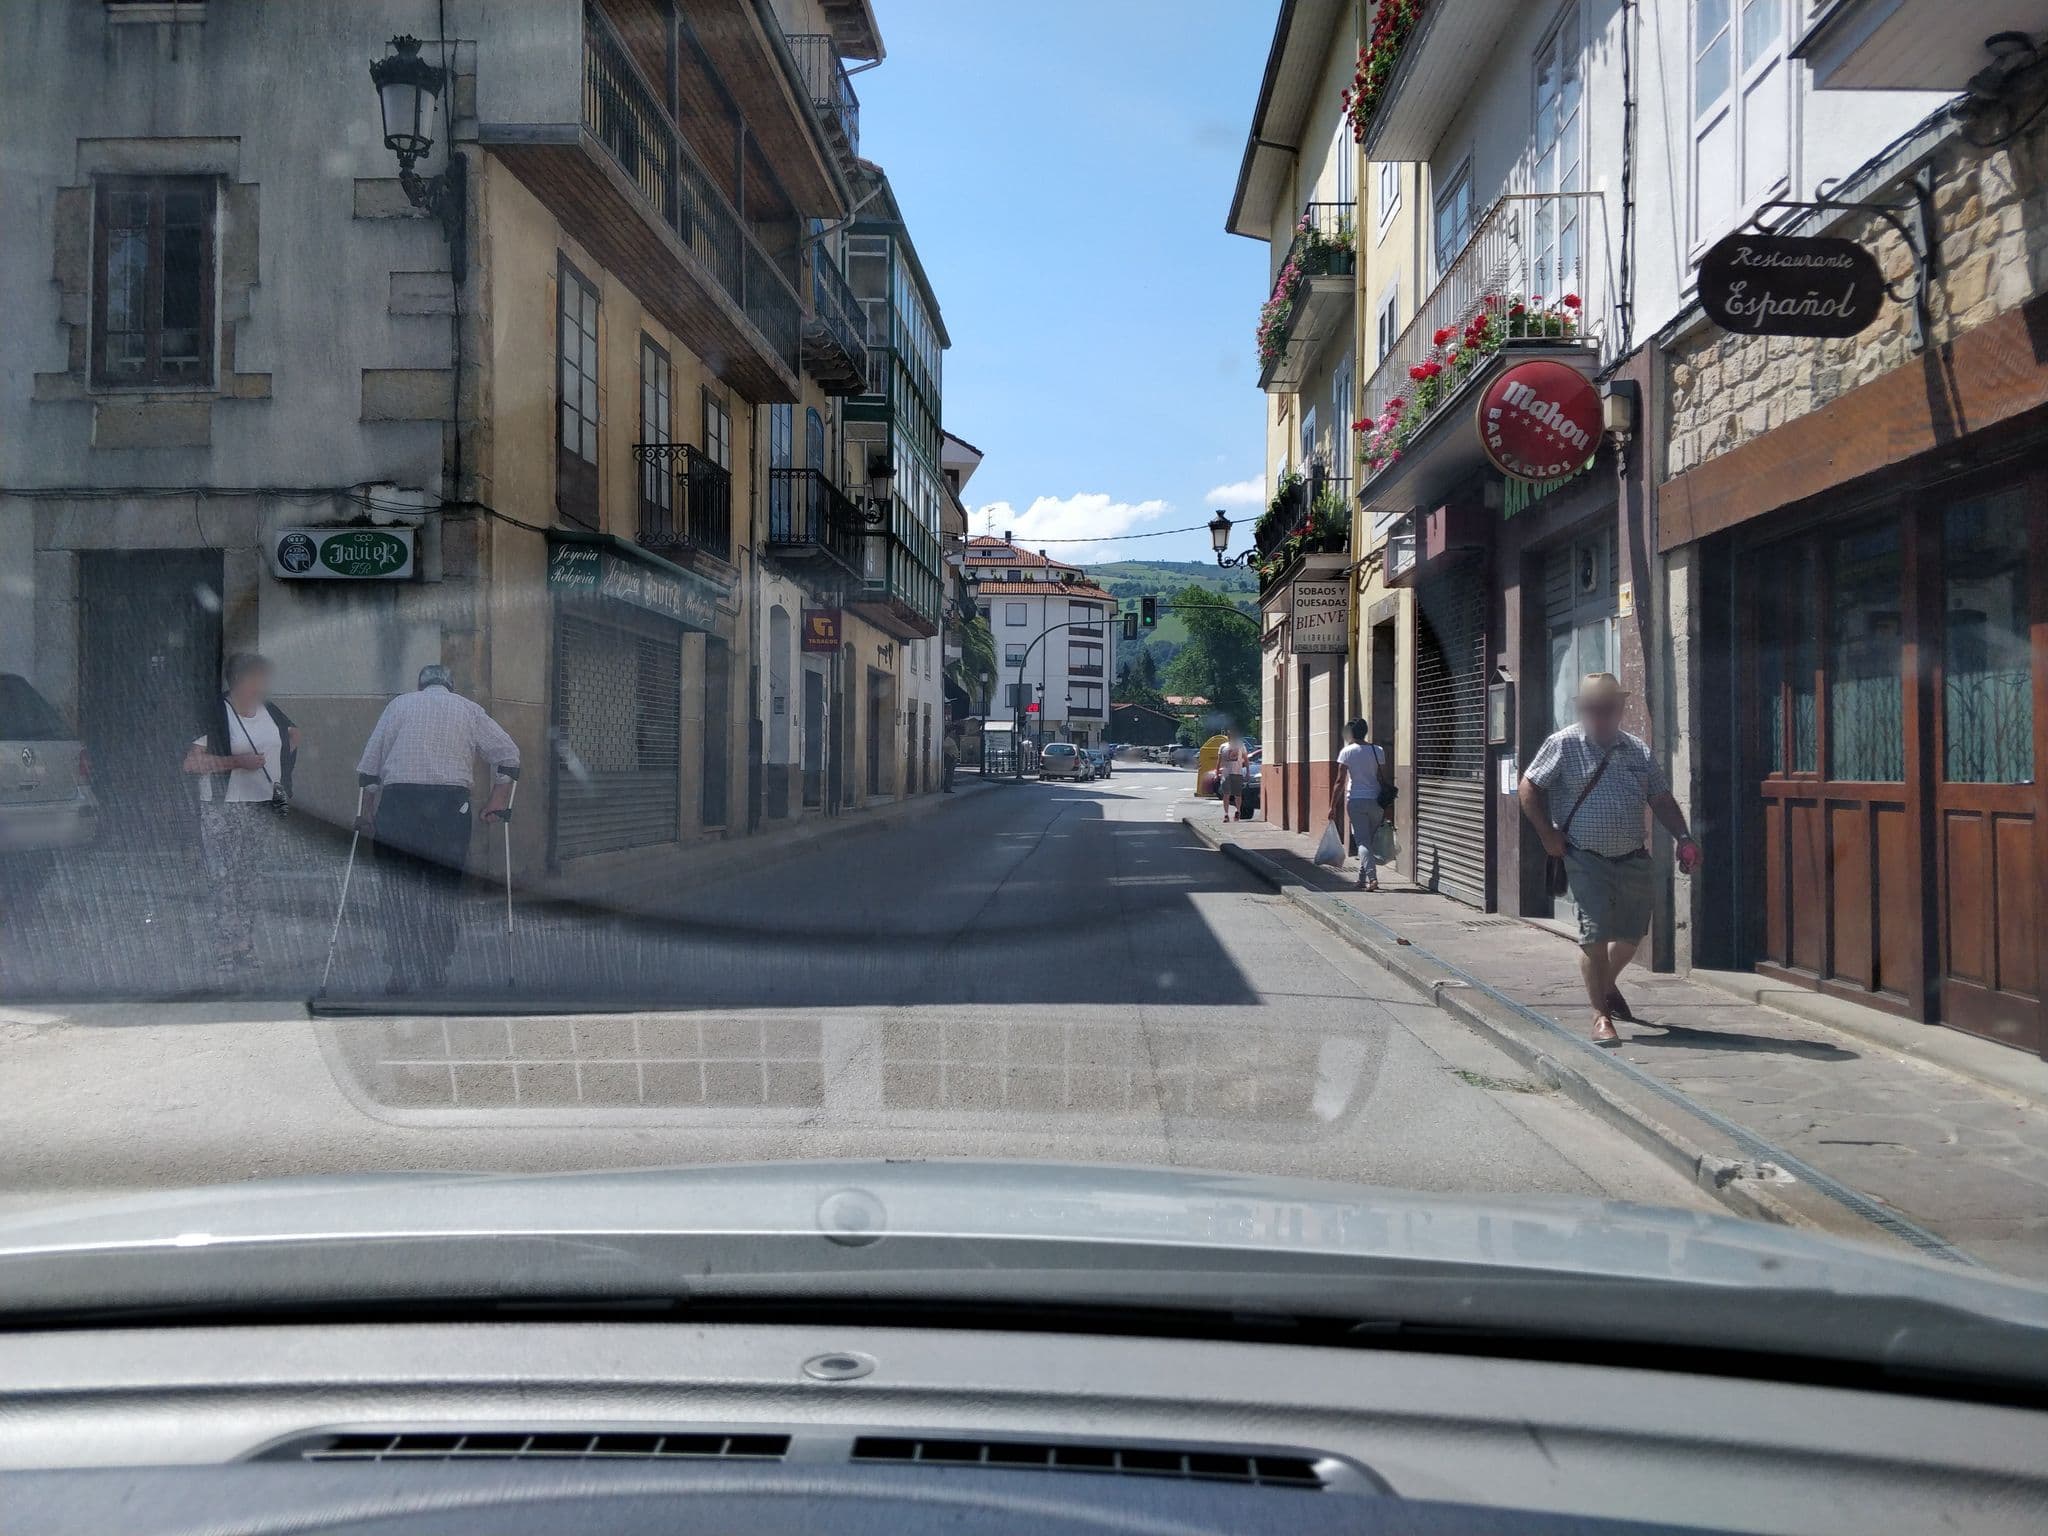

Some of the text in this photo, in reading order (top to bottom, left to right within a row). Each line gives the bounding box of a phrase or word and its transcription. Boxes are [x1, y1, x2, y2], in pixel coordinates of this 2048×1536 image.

[1729, 246, 1856, 269] Restaurante
[1724, 280, 1857, 328] Español
[1487, 407, 1572, 477] BAR CARLOS
[1298, 587, 1346, 596] SOBAOS Y
[1296, 598, 1347, 608] QUESADAS
[1296, 609, 1346, 631] BIENVE
